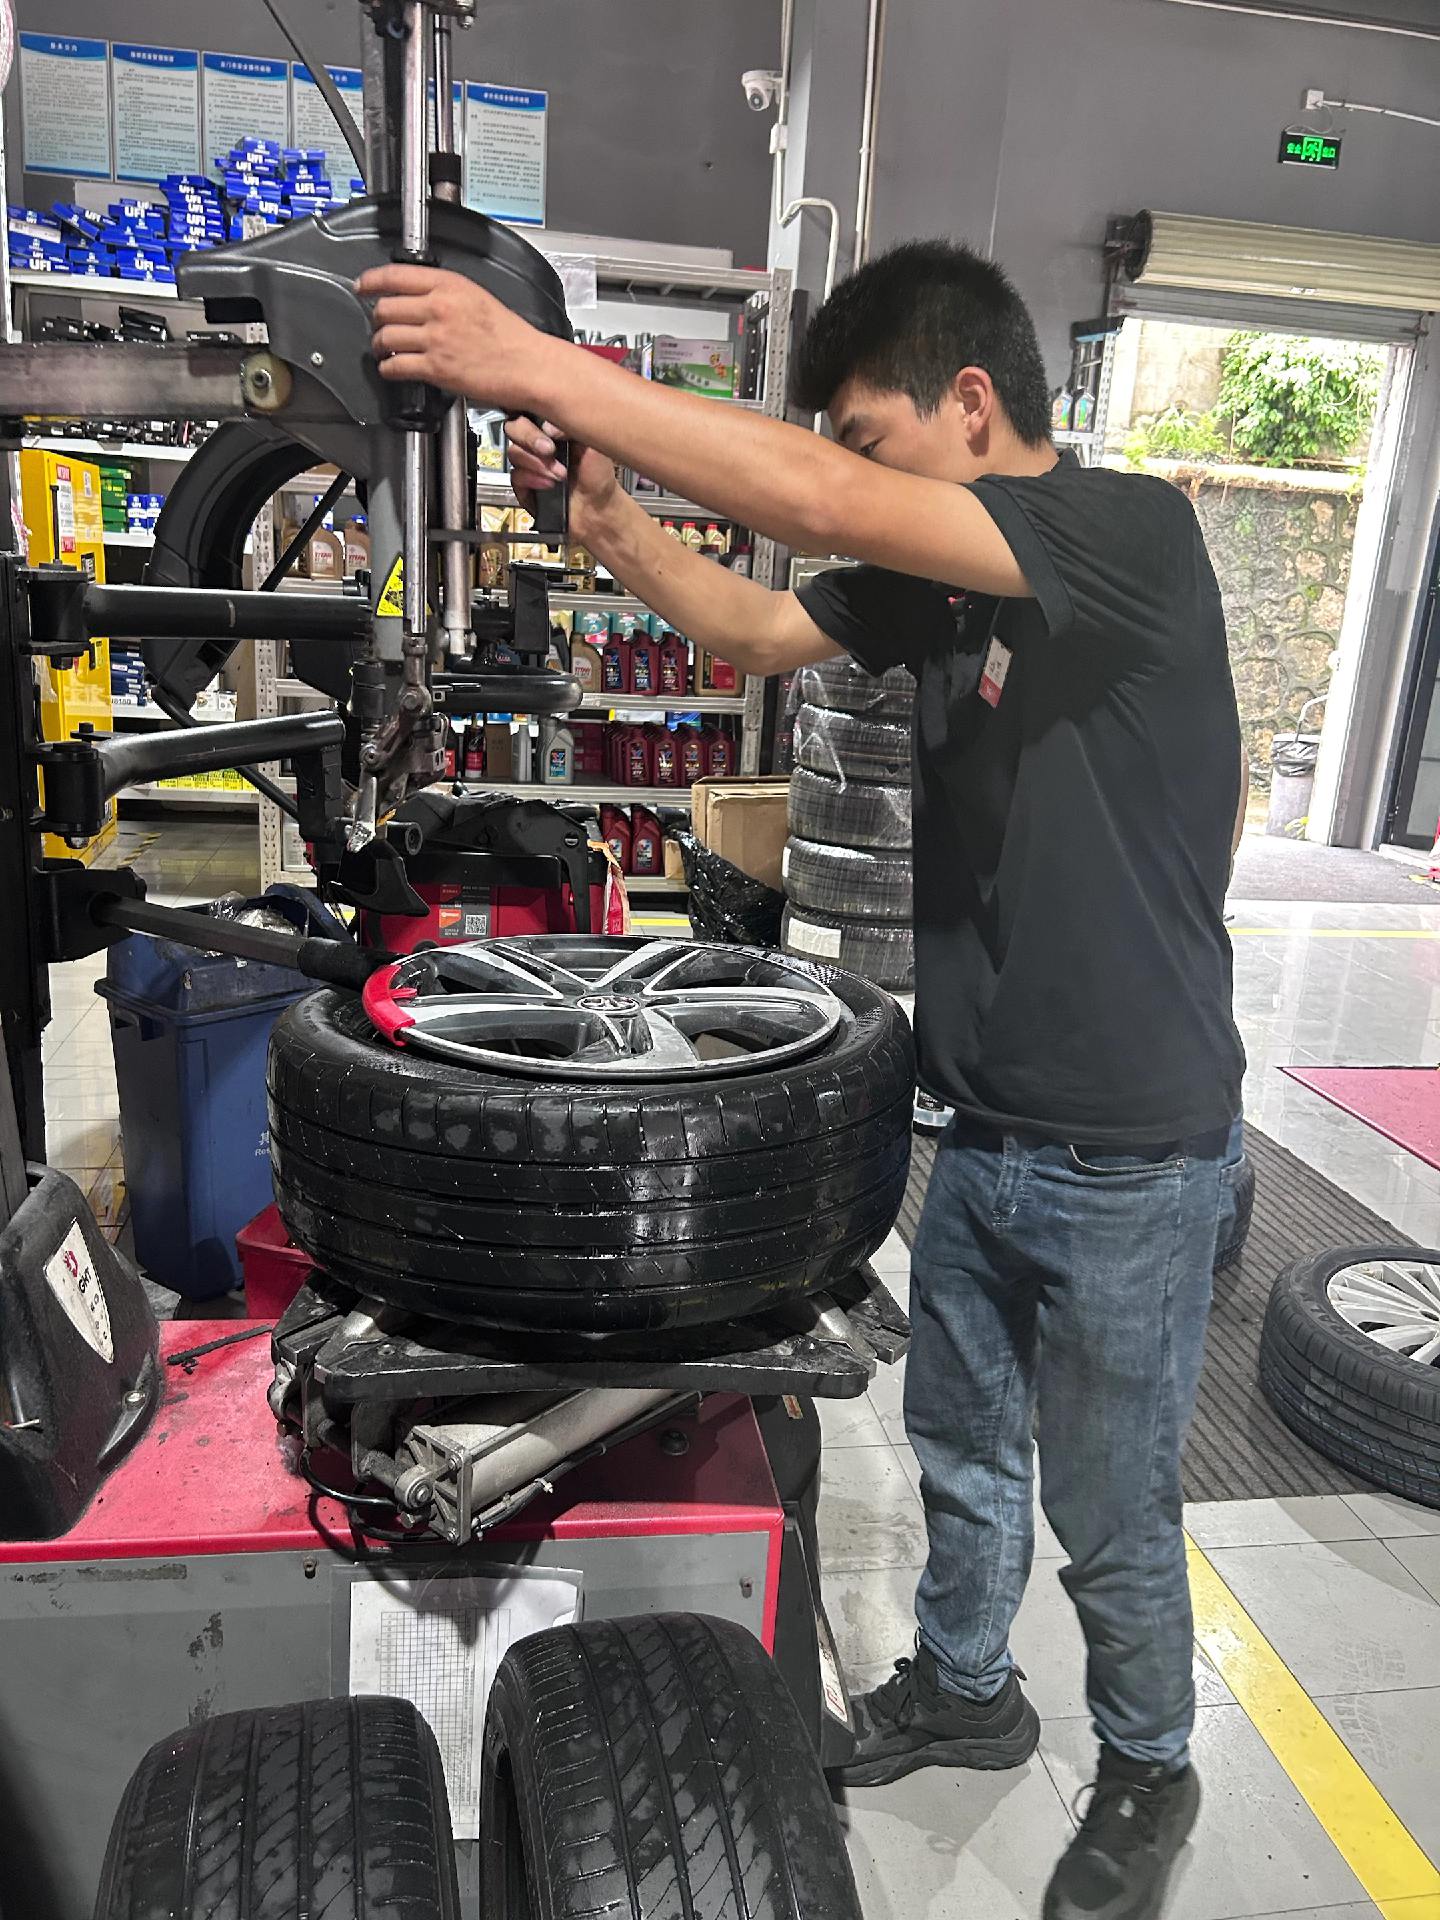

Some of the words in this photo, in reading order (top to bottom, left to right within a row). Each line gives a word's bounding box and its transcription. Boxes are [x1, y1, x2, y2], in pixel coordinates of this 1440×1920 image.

[247, 152, 263, 164] UFI
[236, 161, 252, 171] UFI
[295, 182, 315, 194] UFI
[125, 205, 145, 218] UFI
[259, 200, 279, 215] UFI
[85, 209, 102, 222] UFI
[187, 213, 206, 226] UFI
[190, 226, 206, 237] UFI
[29, 258, 52, 271] UFI
[135, 257, 154, 271] UFI
